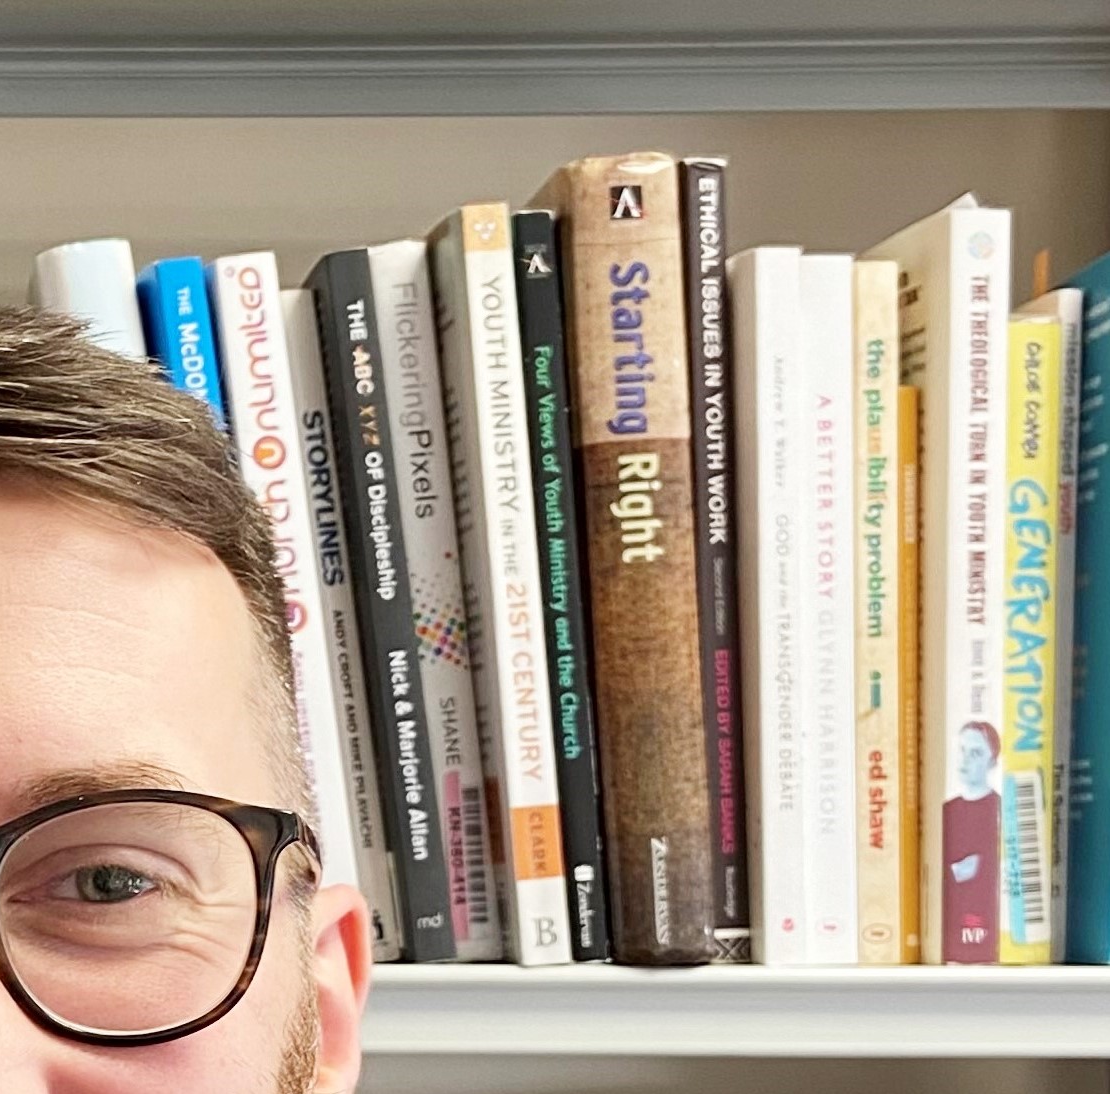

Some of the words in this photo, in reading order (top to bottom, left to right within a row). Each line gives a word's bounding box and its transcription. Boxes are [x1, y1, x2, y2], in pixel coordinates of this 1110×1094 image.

[698, 177, 720, 273] ETHICAL
[176, 285, 192, 316] THE
[701, 277, 723, 359] ISSUES
[971, 274, 990, 303] THE
[346, 299, 368, 342] THE
[481, 274, 510, 371] YOUTH
[606, 260, 657, 436] Starting
[534, 344, 555, 388] Four
[704, 363, 723, 388] IN
[867, 338, 885, 380] the
[968, 311, 989, 414] THEOLOGICAL
[391, 281, 435, 520] FlickeringPixels
[537, 392, 557, 448] Views
[704, 391, 727, 472] YOUTH
[817, 395, 833, 410] A
[363, 451, 386, 483] OF
[488, 378, 522, 514] MINISTRY
[542, 451, 559, 475] of
[817, 418, 834, 512] BETTER
[967, 422, 988, 463] TURN
[302, 410, 345, 587] STORYLINES
[544, 476, 566, 536] Youth
[967, 468, 987, 485] IN
[500, 518, 516, 538] IN
[610, 452, 666, 565] Right
[708, 474, 728, 545] WORK
[966, 489, 987, 543] YOUTH
[367, 483, 399, 602] Discipleship
[501, 539, 521, 578] THE
[817, 520, 835, 600] STORY
[545, 537, 570, 613] Ministry
[864, 533, 888, 639] problem
[965, 549, 987, 627] MINISTRY
[554, 614, 574, 652] and
[1002, 478, 1053, 753] GENERATION
[332, 609, 345, 650] ANDY
[344, 702, 357, 735] AND
[388, 648, 409, 698] Nick
[557, 652, 578, 687] the
[714, 648, 731, 710] EDITED
[394, 699, 415, 718] &
[439, 695, 462, 767] SHANE
[510, 648, 543, 784] CENTURY
[560, 691, 583, 760] Church
[717, 711, 731, 736] BY
[397, 719, 424, 805] Marjorie
[718, 738, 734, 796] SARAH
[777, 748, 794, 813] DEBATE
[868, 749, 888, 782] ed
[408, 806, 429, 862] Allan
[528, 809, 548, 874] CLARK
[721, 799, 736, 855] BANKS
[868, 787, 888, 851] shaw
